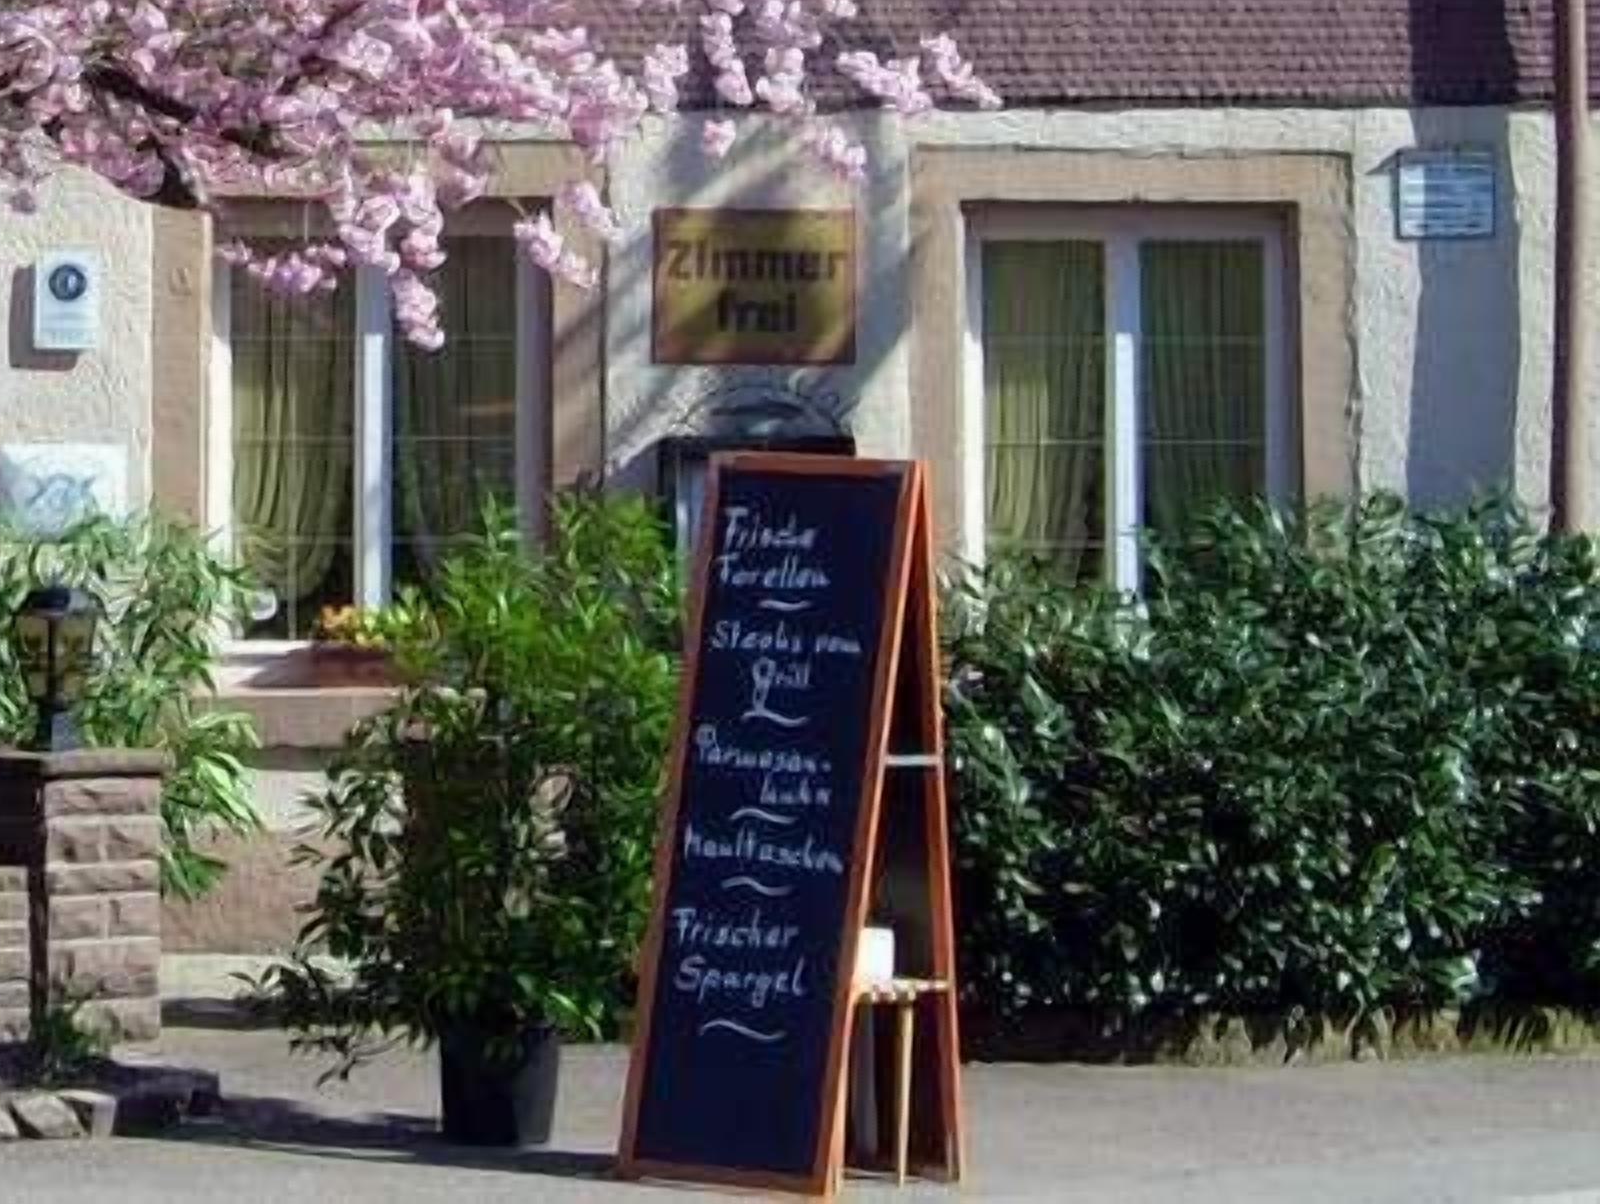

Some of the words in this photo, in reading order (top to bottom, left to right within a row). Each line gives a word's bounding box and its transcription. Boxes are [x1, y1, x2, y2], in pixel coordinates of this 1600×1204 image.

[666, 240, 848, 281] Zimmer
[717, 289, 797, 333] frei
[672, 907, 800, 946] Frischer
[673, 956, 806, 1009] Spargel
